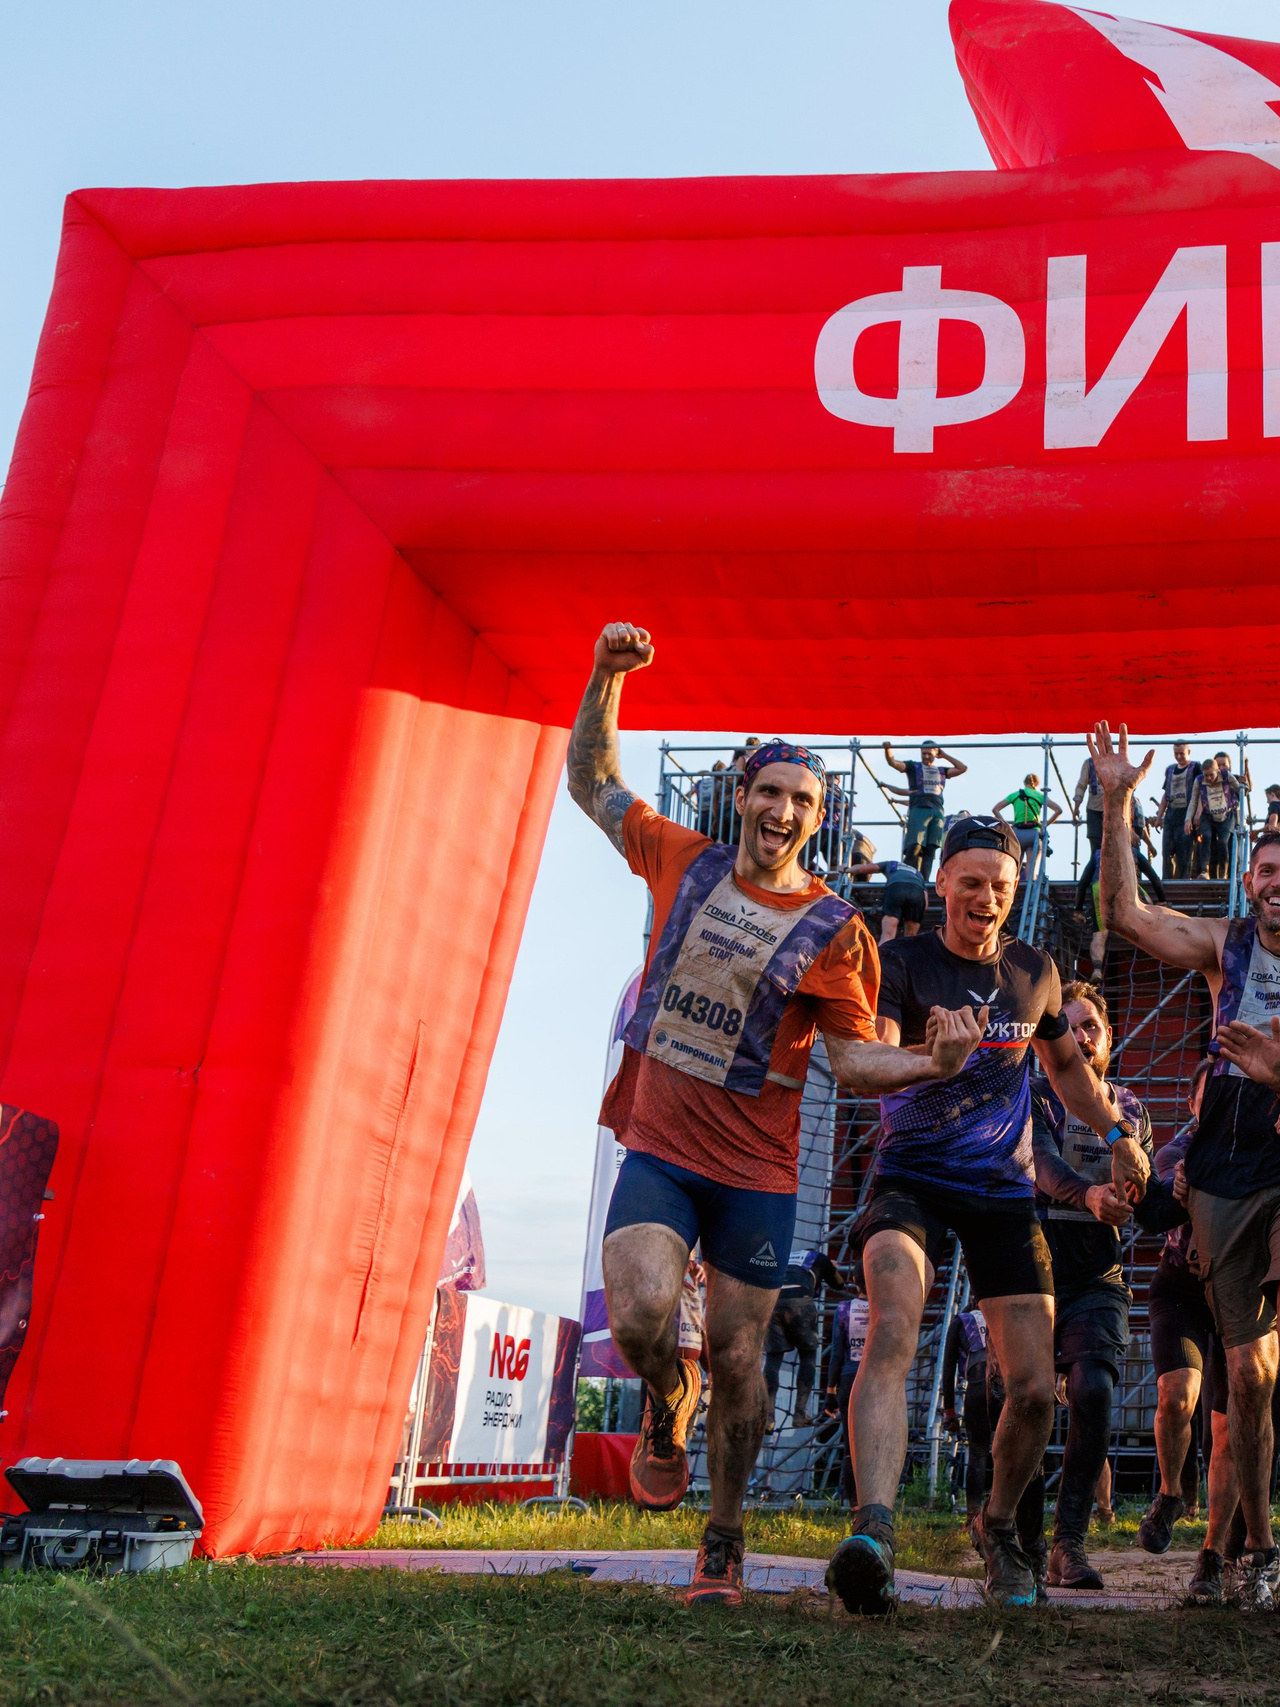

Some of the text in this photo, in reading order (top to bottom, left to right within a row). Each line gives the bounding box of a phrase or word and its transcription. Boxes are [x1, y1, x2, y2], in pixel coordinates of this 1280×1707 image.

[705, 904, 778, 943] ГОНКА ГЕРОЕВ
[700, 928, 757, 959] КОМАНДНЫЙ
[708, 946, 735, 963] СТАРТ
[663, 984, 743, 1037] 04308
[985, 1022, 1037, 1038] УКТОР
[670, 1039, 727, 1069] ГАЗПРОМБАНК
[1067, 1124, 1092, 1132] ГОНКА
[1081, 1154, 1102, 1164] СТАРТ
[749, 1257, 778, 1267] Reebok
[489, 1332, 531, 1381] NRG
[486, 1391, 513, 1407] РАДИО
[482, 1411, 523, 1430] ЭНЕРДЖИ
